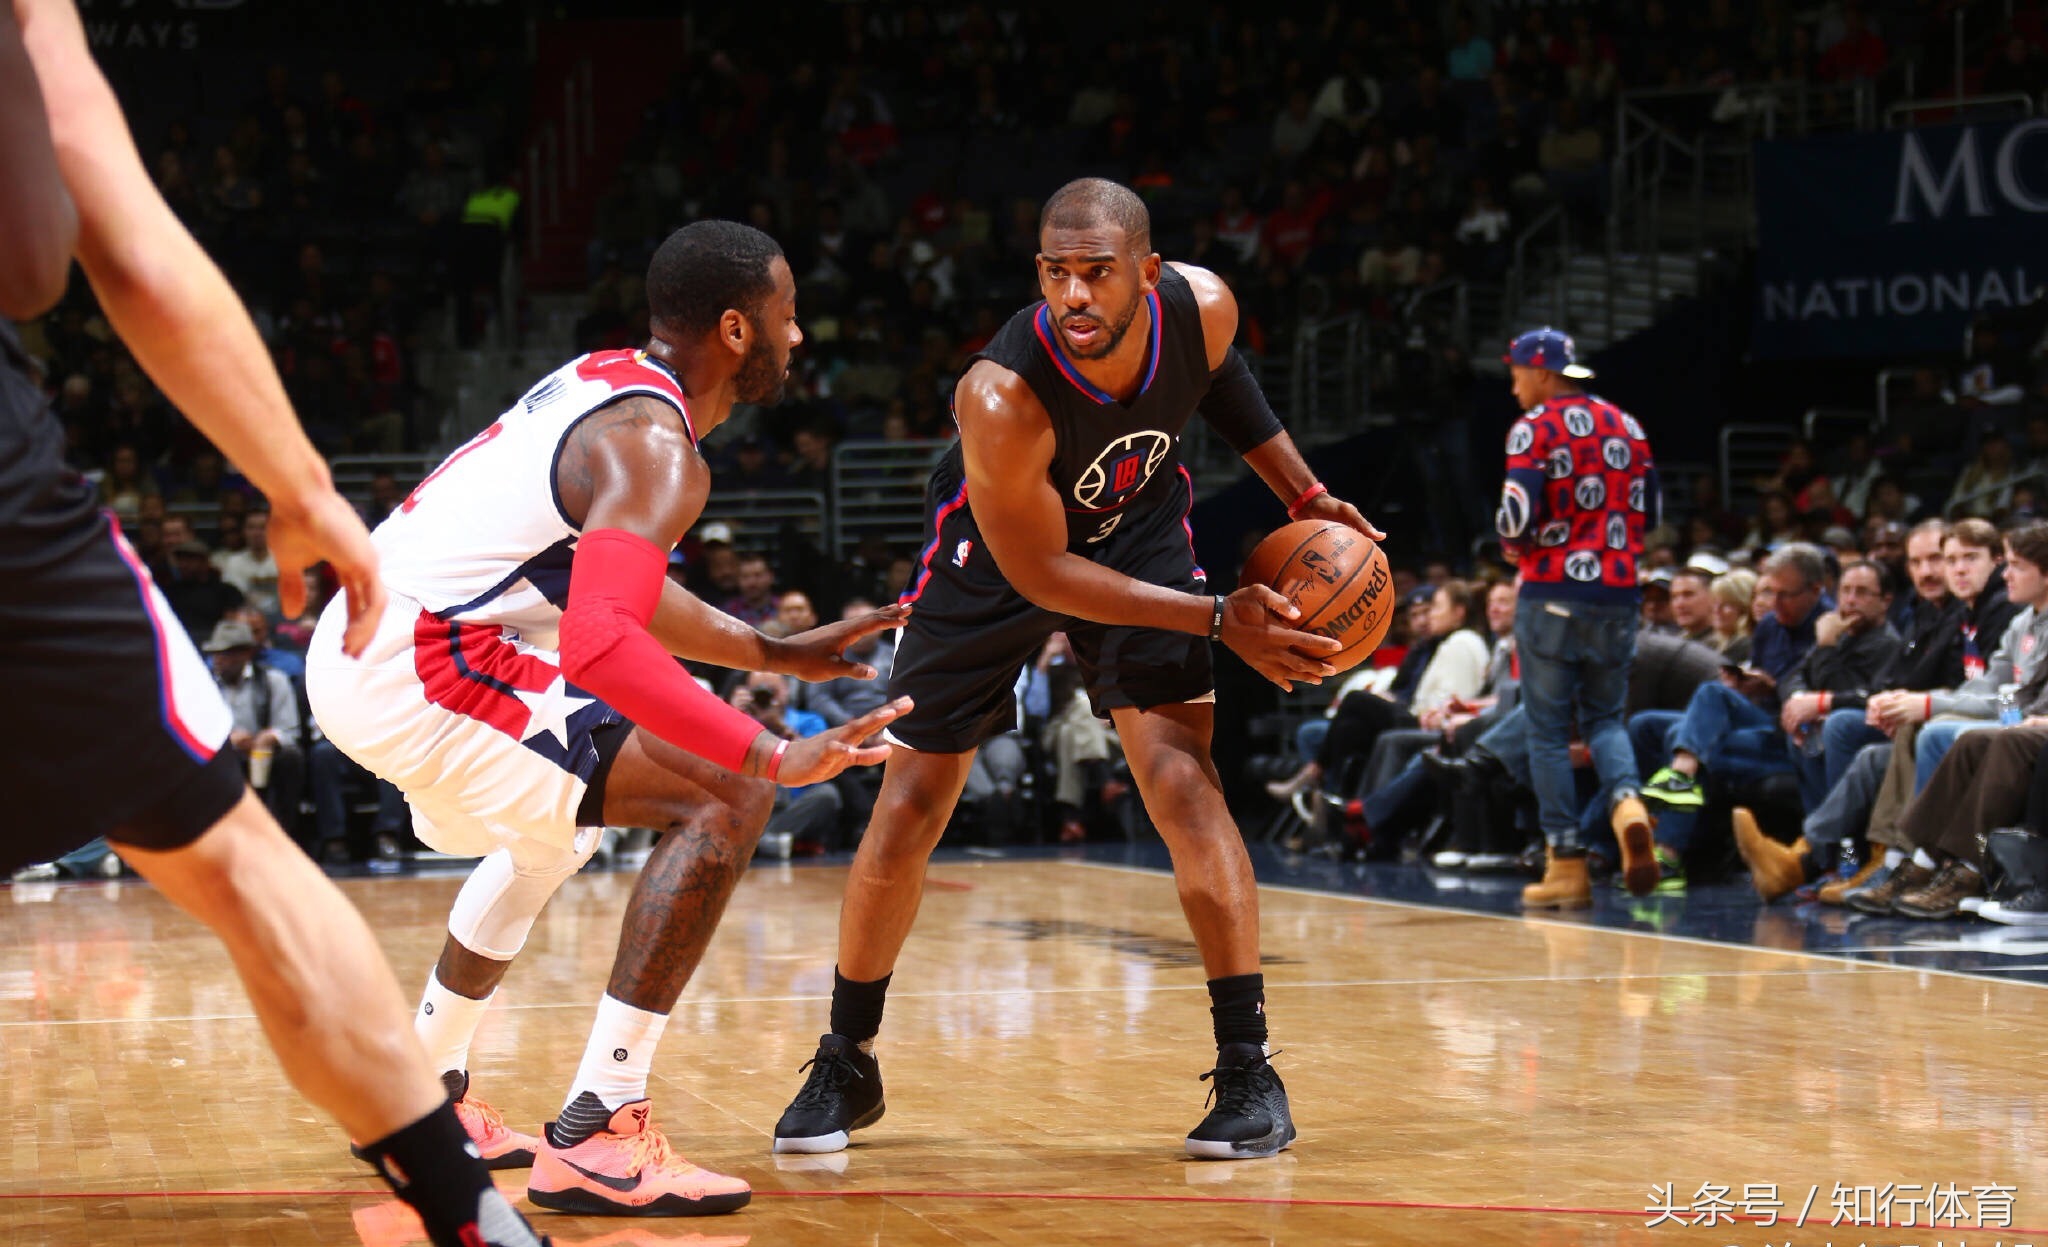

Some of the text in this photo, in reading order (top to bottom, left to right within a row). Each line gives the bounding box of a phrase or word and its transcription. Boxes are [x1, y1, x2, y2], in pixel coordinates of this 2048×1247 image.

[1762, 265, 2034, 321] NATIONAL
[1113, 455, 1139, 493] LA
[1086, 513, 1123, 543] 3
